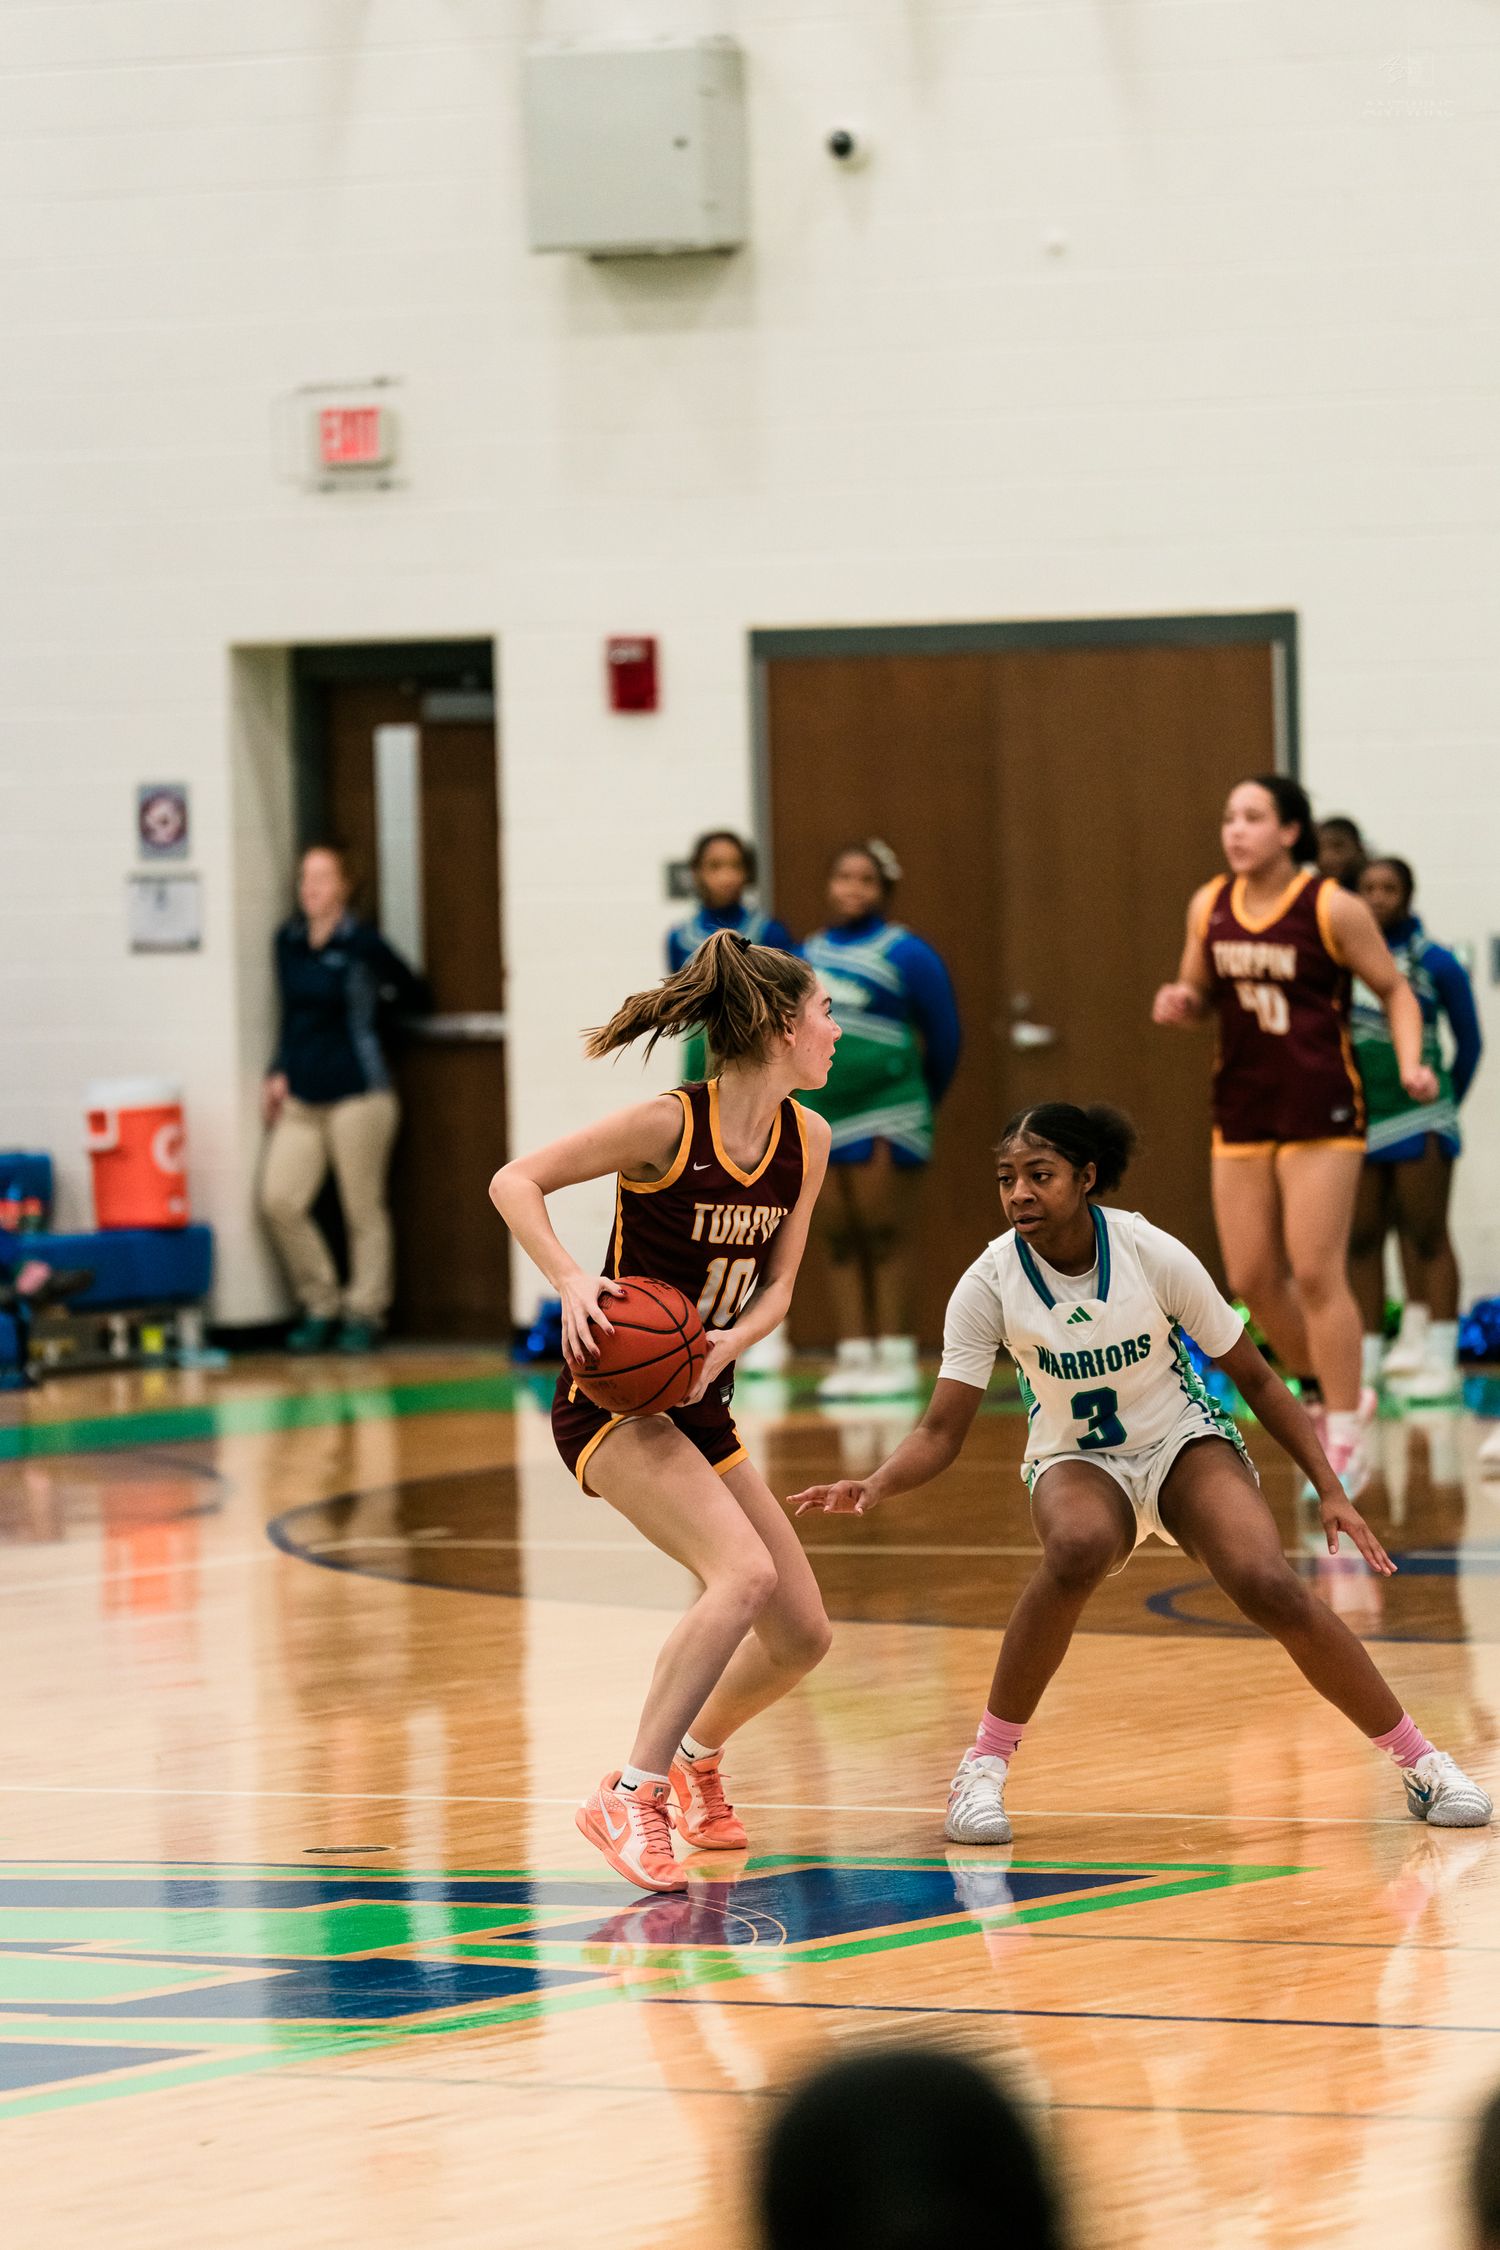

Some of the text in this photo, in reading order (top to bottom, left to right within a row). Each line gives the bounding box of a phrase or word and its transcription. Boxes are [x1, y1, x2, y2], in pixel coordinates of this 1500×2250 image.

[696, 1257, 760, 1328] 10
[1033, 1333, 1151, 1380] WARRIORS
[1070, 1386, 1128, 1450] 3
